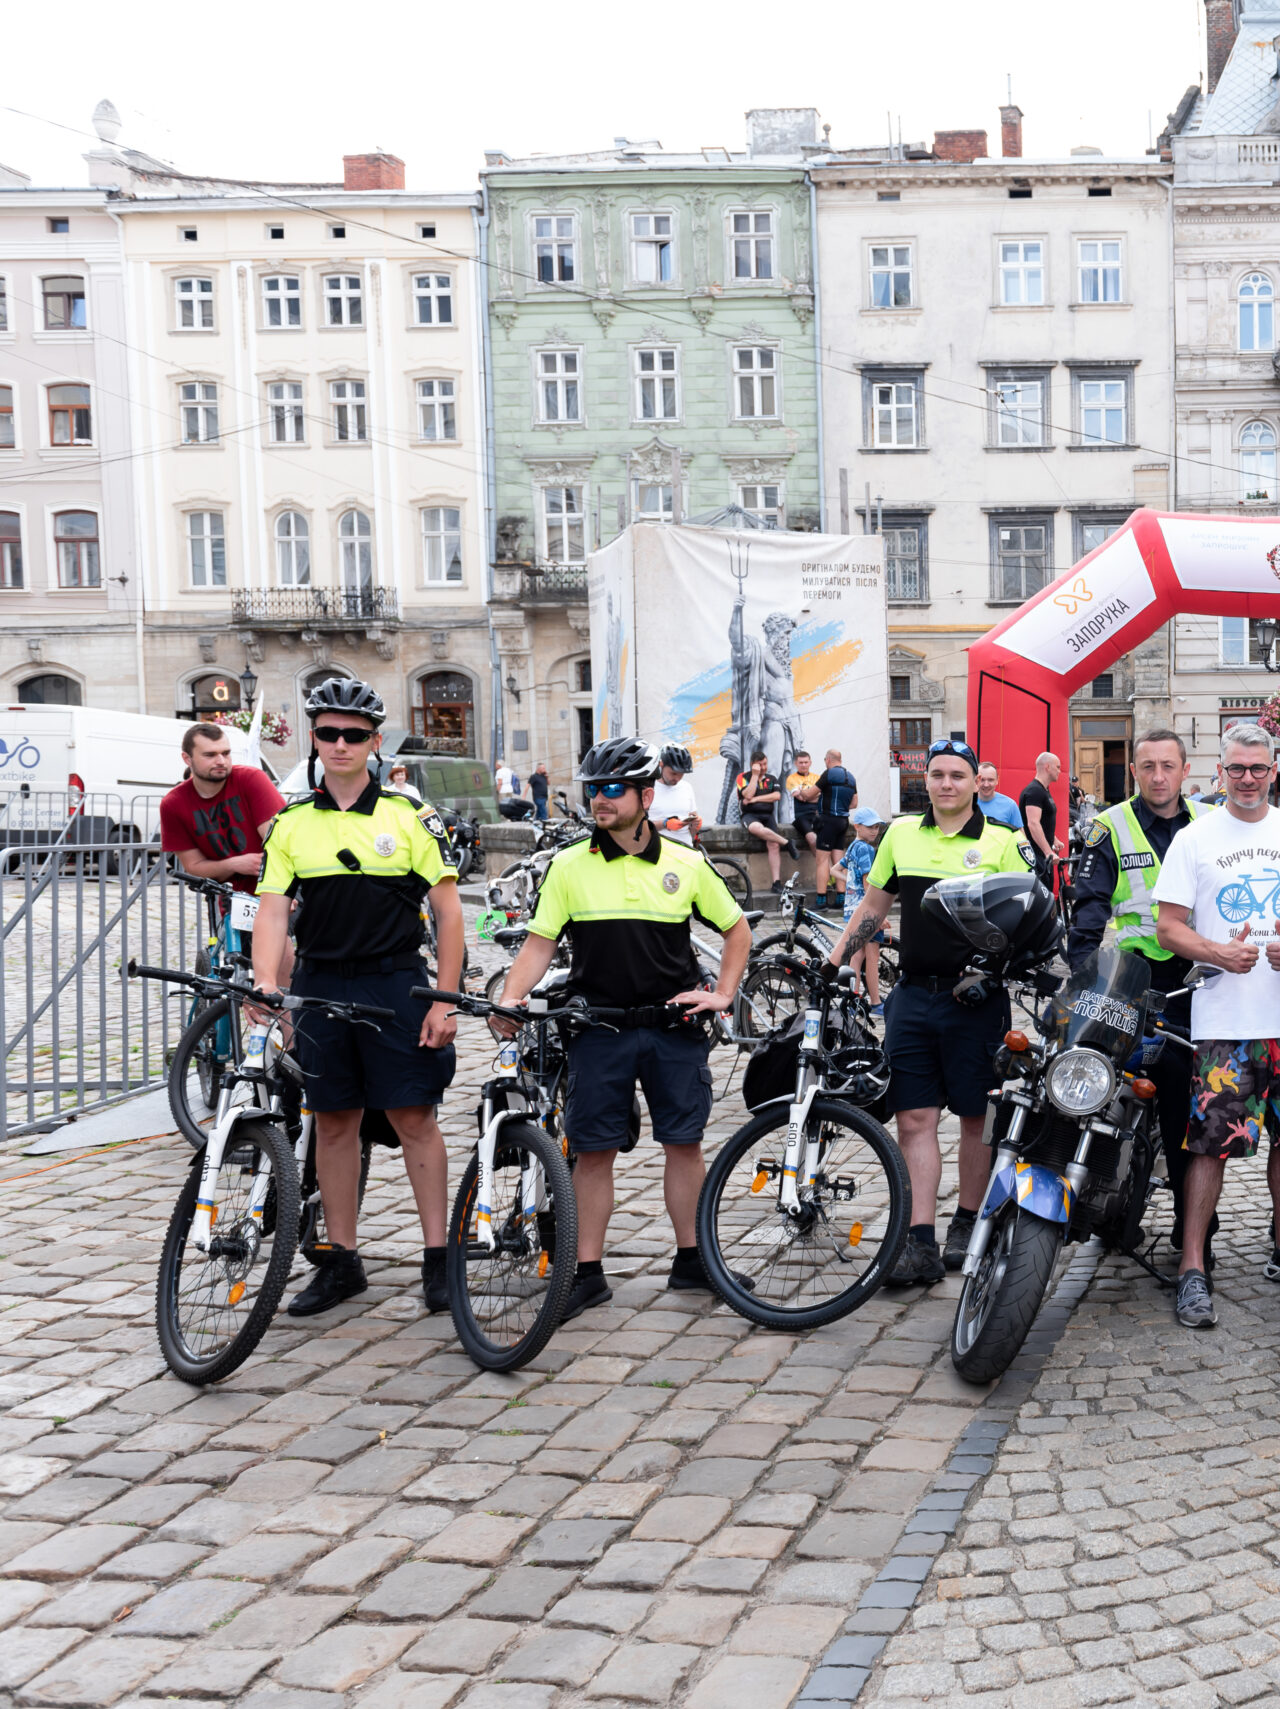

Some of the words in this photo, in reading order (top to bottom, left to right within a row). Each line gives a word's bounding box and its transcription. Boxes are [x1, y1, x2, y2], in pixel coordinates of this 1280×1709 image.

[801, 562, 850, 573] ОРИГІНАЛОМ
[851, 563, 882, 575] БУДЕМО
[802, 576, 851, 587] МИЛУВАТИСЯ
[855, 577, 878, 588] ПІСЛЯ
[803, 590, 842, 601] ПЕРЕМОГИ
[1066, 598, 1130, 653] ЗАПОРУКА
[0, 771, 37, 782] xtbike
[18, 808, 33, 817] Call
[192, 795, 246, 837] JUST
[207, 826, 248, 858] DO
[1215, 848, 1255, 870] Кручу
[1249, 928, 1269, 937] вони
[1074, 1000, 1138, 1037] ПОЛІЦІЯ
